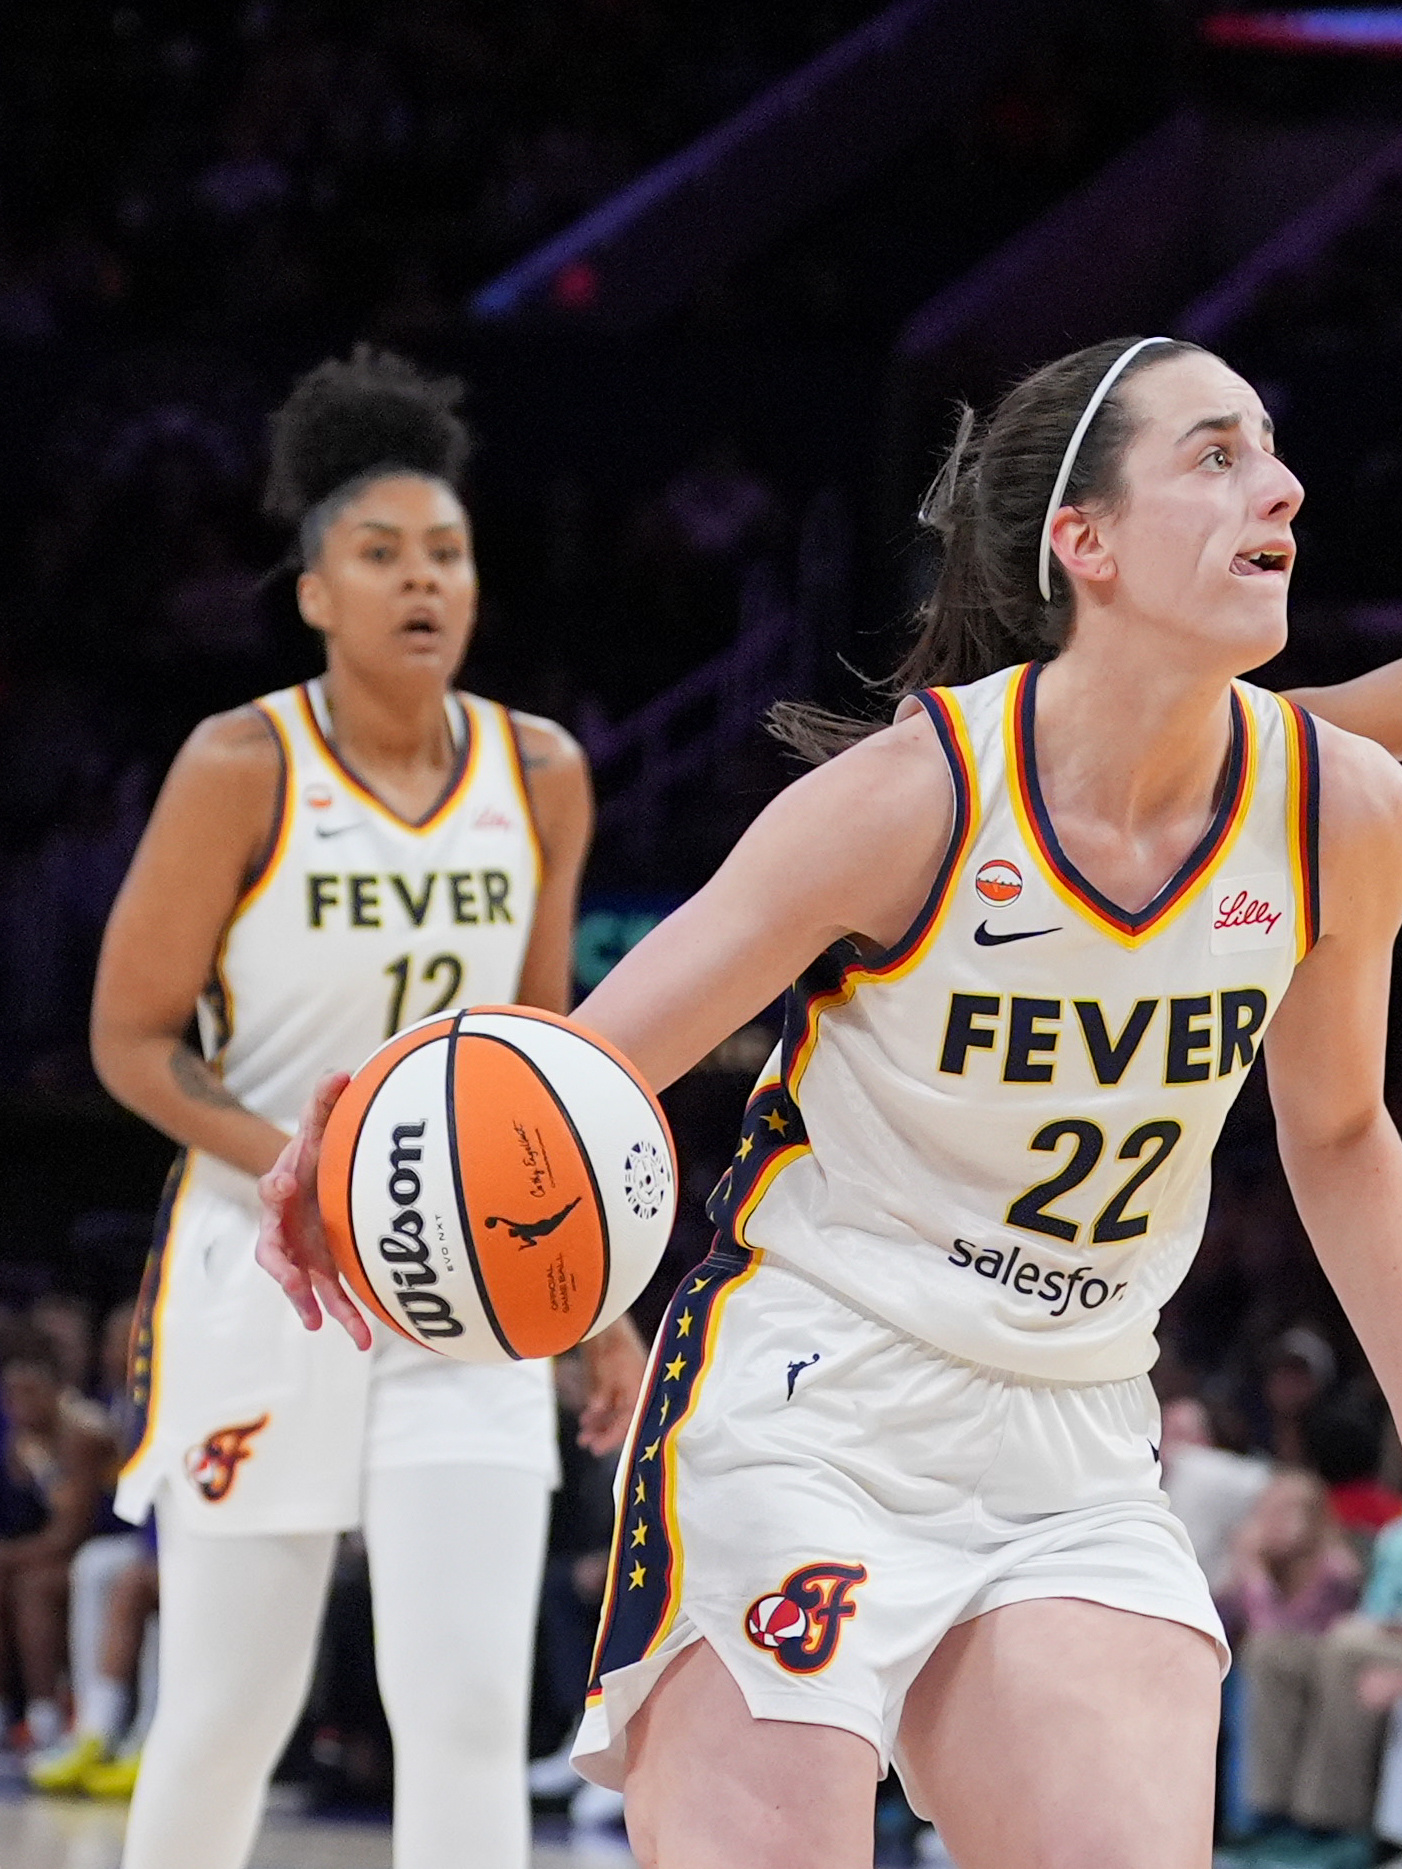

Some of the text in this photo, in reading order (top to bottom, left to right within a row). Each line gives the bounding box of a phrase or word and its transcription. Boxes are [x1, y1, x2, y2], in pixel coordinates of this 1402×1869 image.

[307, 867, 515, 929] FEVER
[1214, 890, 1282, 935] Lilly
[383, 951, 466, 1040] 12
[937, 985, 1269, 1089] FEVER
[1002, 1115, 1186, 1247] 22
[378, 1116, 466, 1341] Wilson
[434, 1214, 454, 1272] EVO NXT
